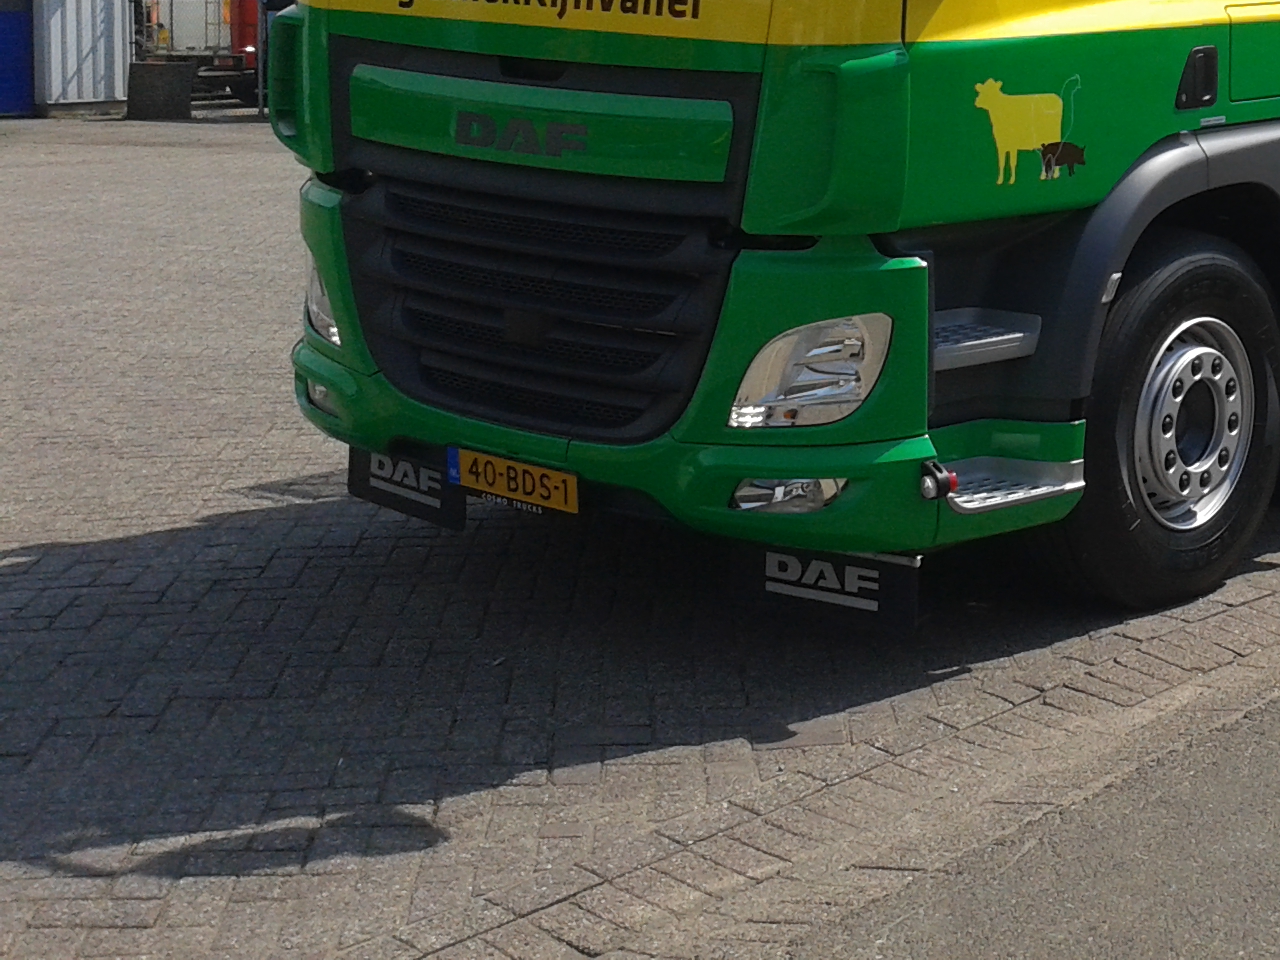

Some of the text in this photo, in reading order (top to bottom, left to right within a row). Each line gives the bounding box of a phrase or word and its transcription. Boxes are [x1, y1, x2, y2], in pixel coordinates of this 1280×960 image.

[454, 110, 588, 158] DAF
[370, 452, 441, 492] DAF
[468, 457, 569, 506] 40-BDS-1
[512, 500, 543, 515] TRUCKS
[765, 551, 880, 593] DAF
